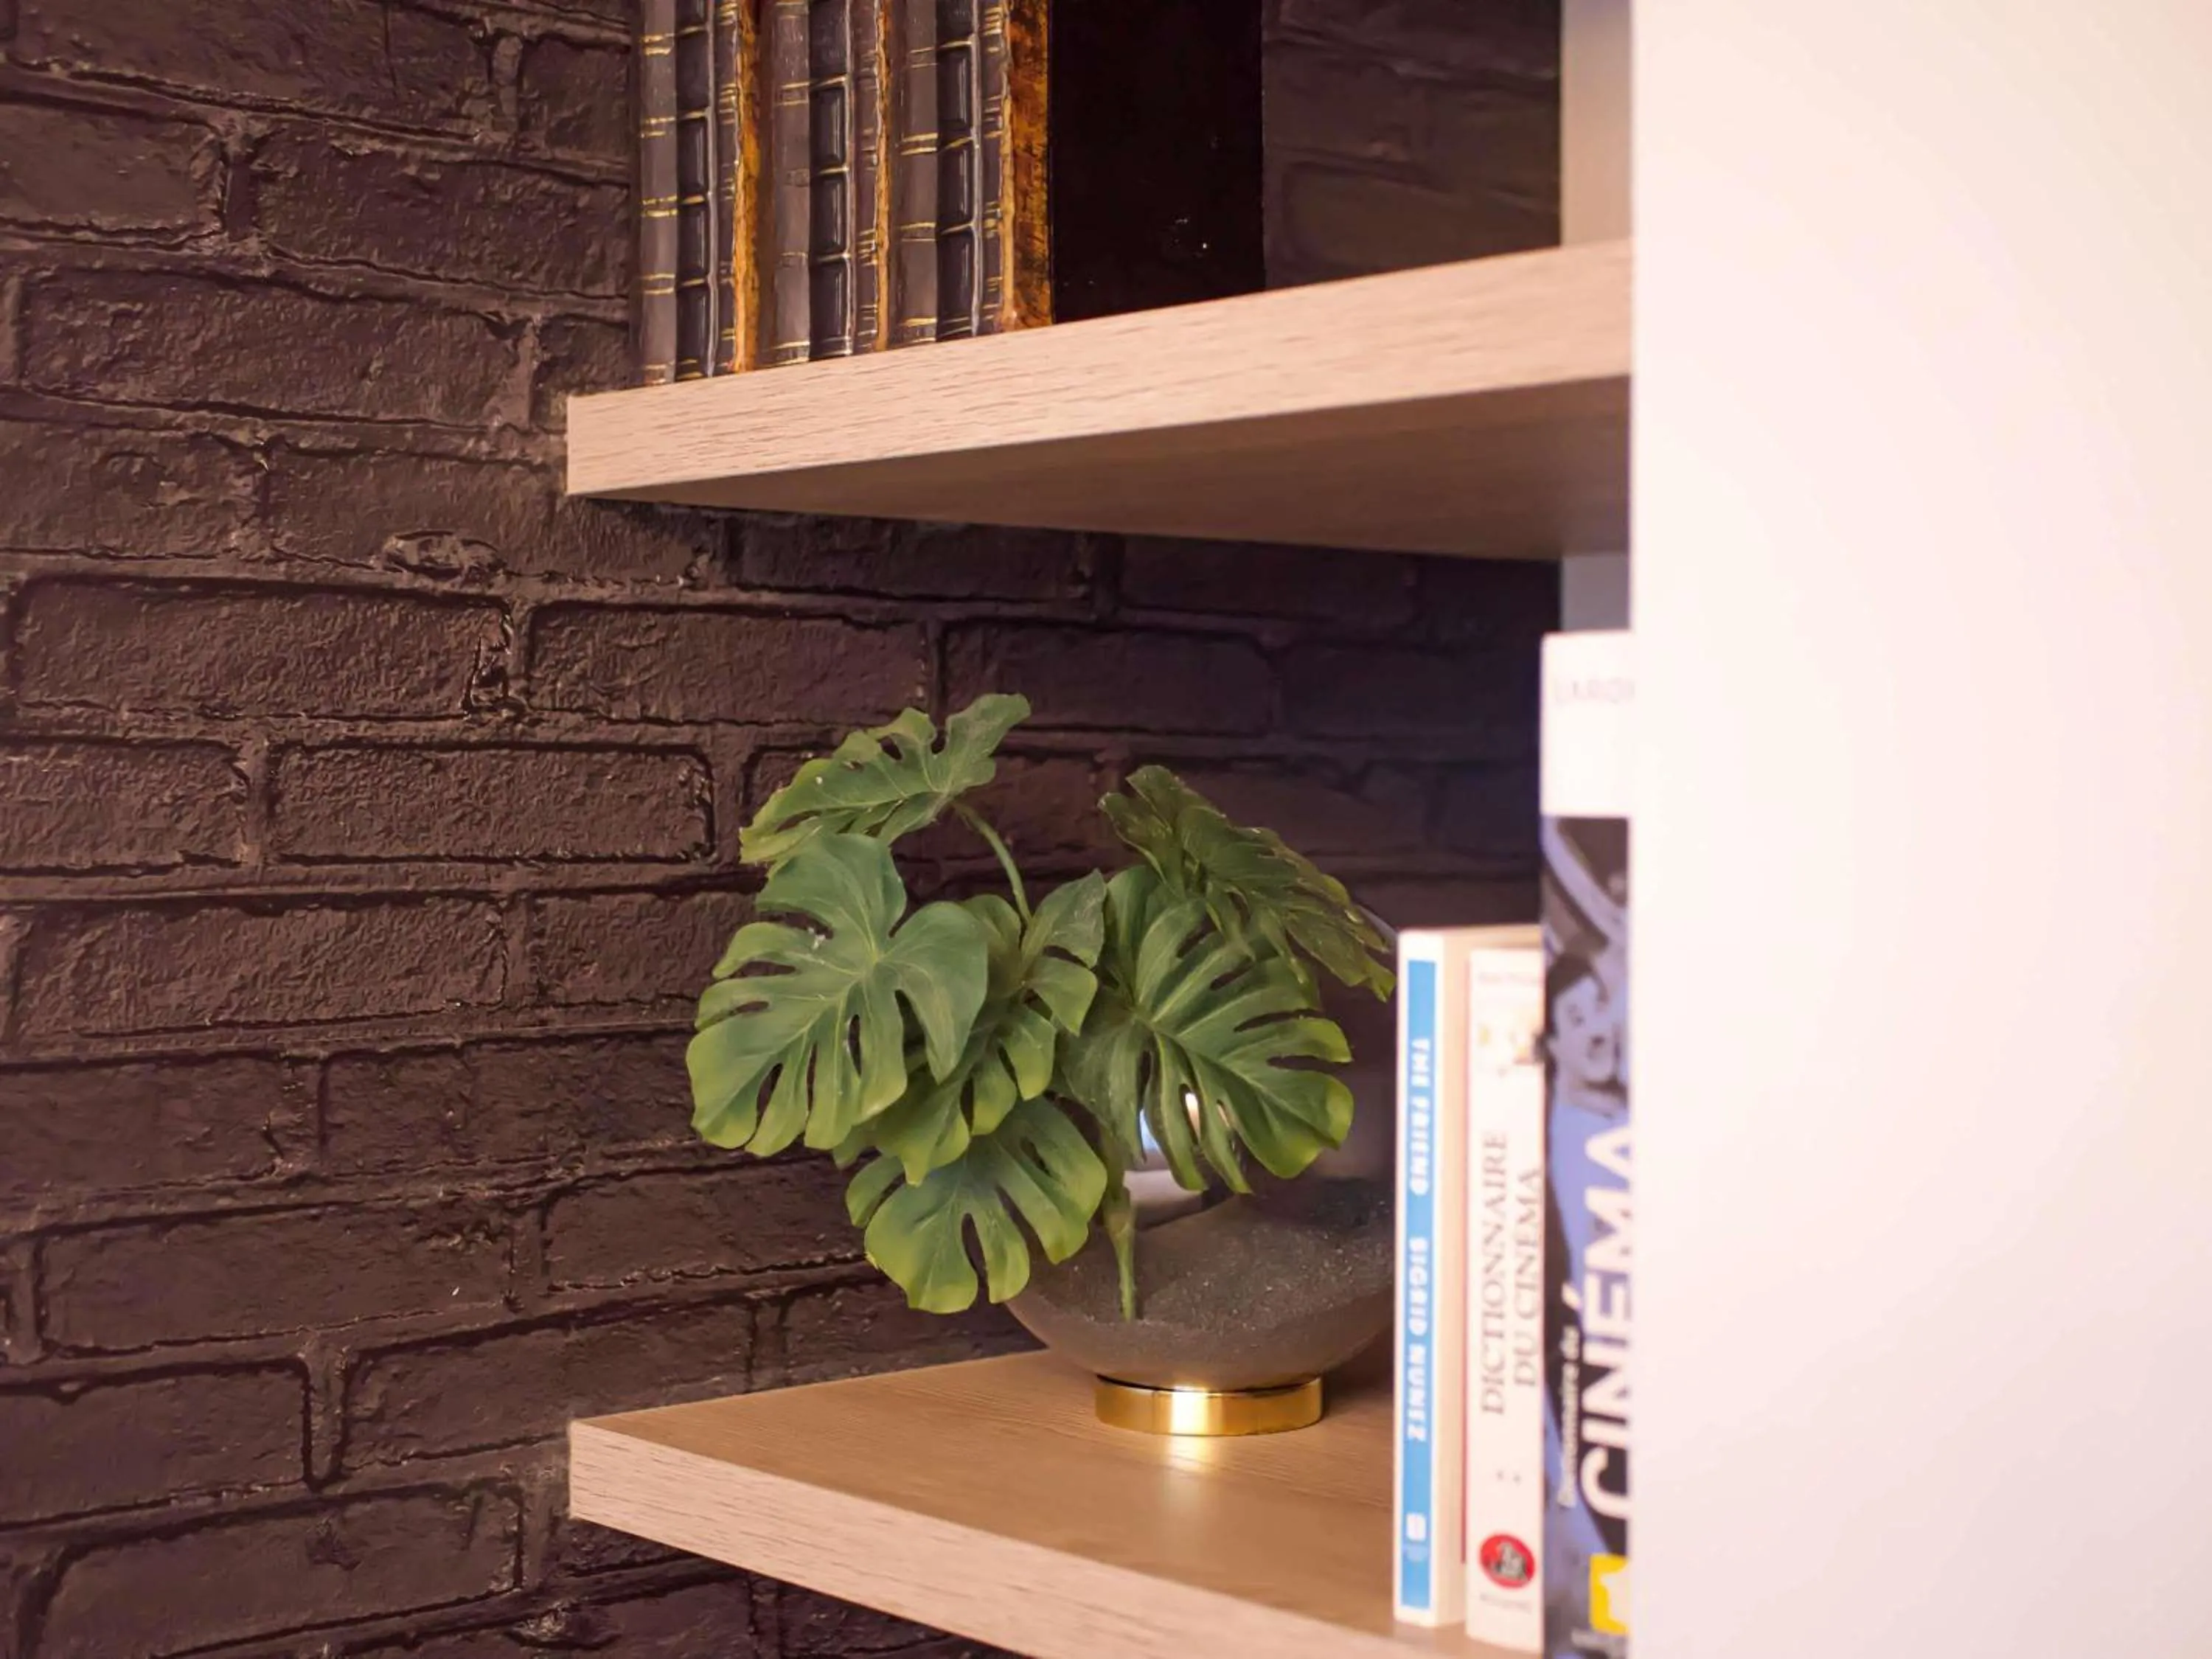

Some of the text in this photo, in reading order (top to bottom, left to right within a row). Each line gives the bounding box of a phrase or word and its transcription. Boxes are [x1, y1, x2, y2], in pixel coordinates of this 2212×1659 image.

[1410, 1038, 1430, 1195] THE FRIEND
[1407, 1237, 1428, 1441] SIGRID NUNEZ
[1481, 1130, 1508, 1415] DICTIONNAIRE
[1514, 1332, 1537, 1388] DU
[1559, 1326, 1582, 1361] du
[1562, 1126, 1630, 1520] CINÉMA
